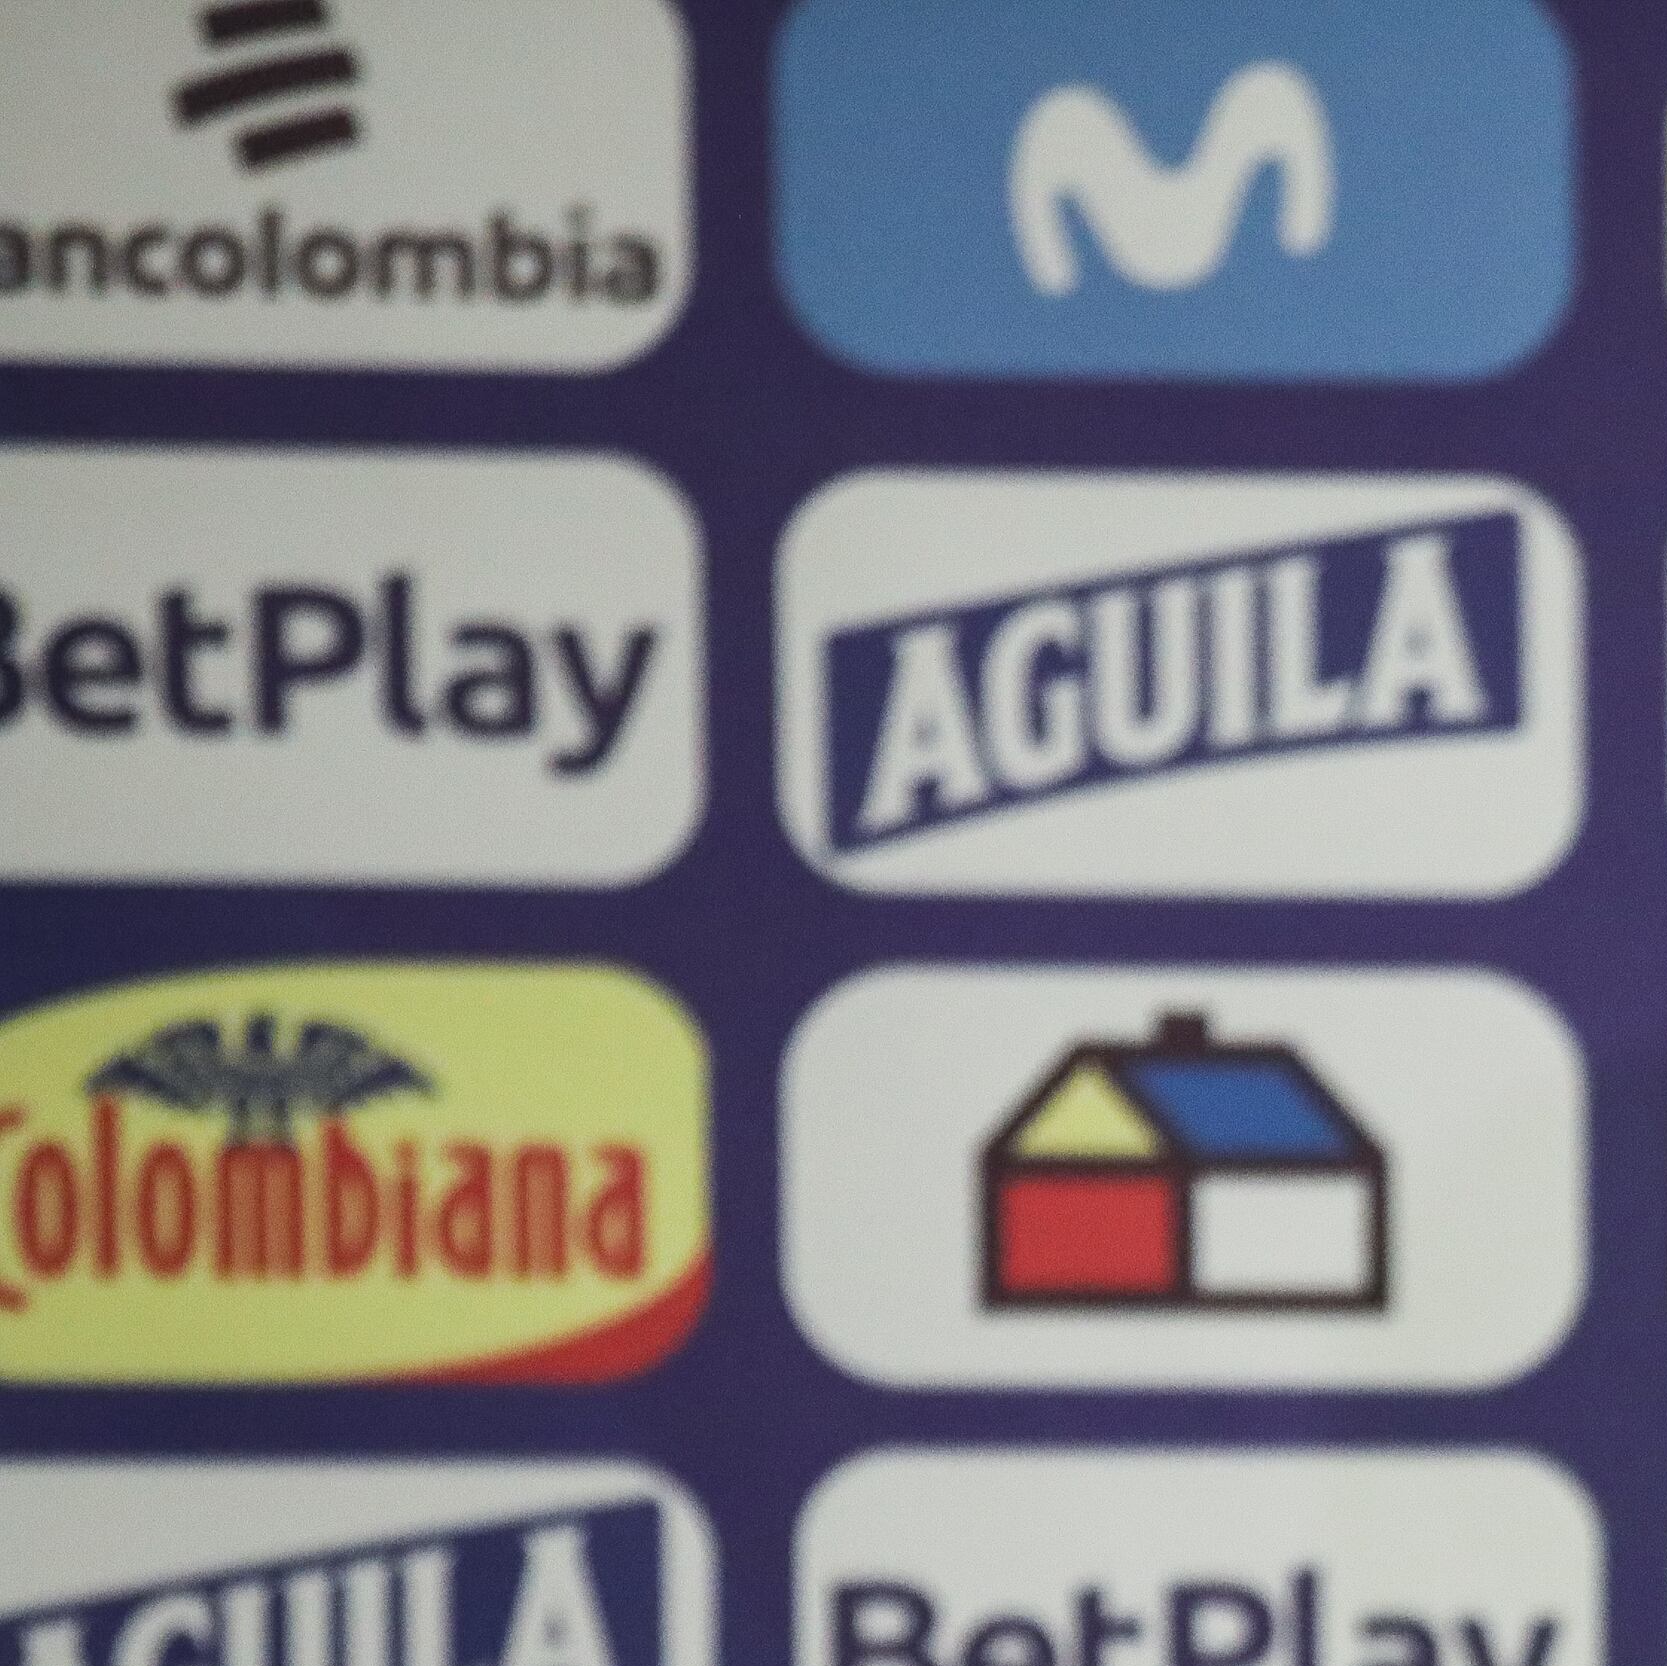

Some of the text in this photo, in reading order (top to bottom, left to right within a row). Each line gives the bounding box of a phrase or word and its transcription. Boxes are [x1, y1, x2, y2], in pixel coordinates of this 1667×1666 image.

[0, 205, 664, 306] ancolombia
[0, 570, 659, 780] etPlay
[856, 533, 1487, 836] AGUILA
[0, 1093, 652, 1311] olombiana
